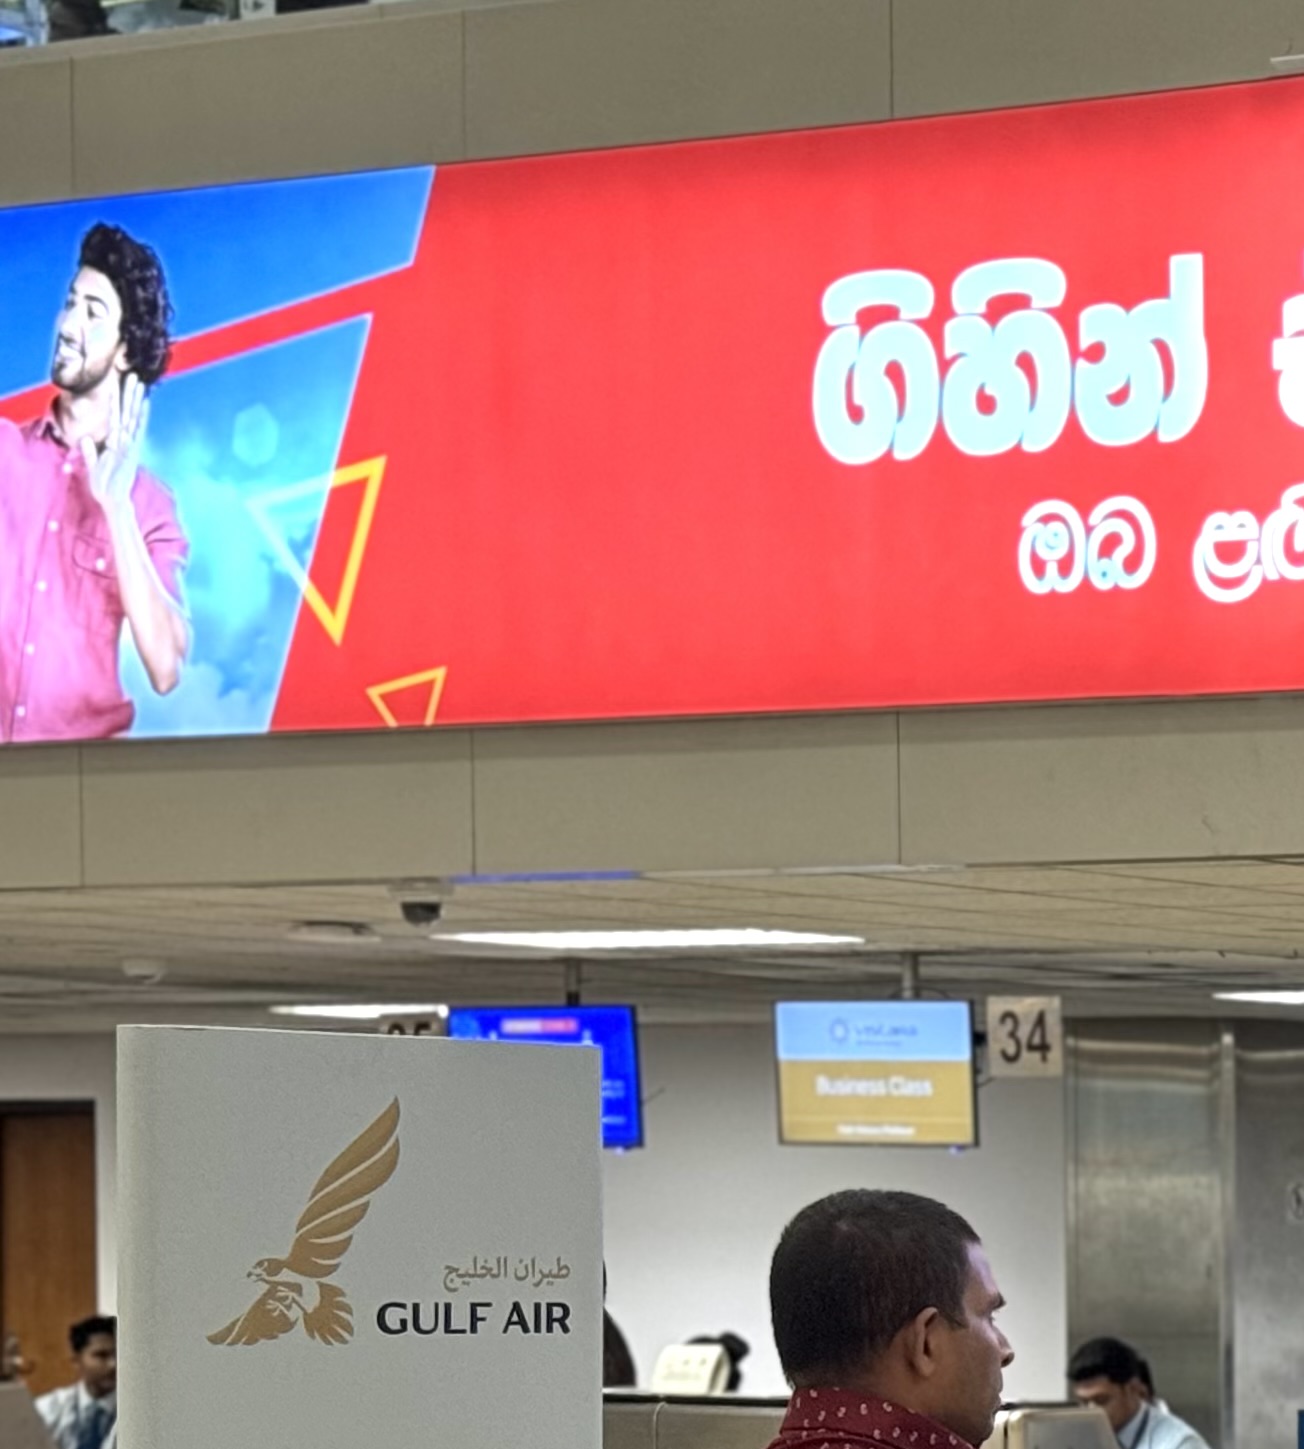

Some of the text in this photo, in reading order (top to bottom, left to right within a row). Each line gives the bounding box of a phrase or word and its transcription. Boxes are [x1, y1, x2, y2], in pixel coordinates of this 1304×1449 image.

[811, 252, 1209, 466] ගිහින්
[1018, 495, 1157, 596] ඔබ
[998, 1008, 1052, 1064] 34
[442, 1255, 571, 1293] طيران الخليج
[376, 1301, 571, 1335] GULF AIR
